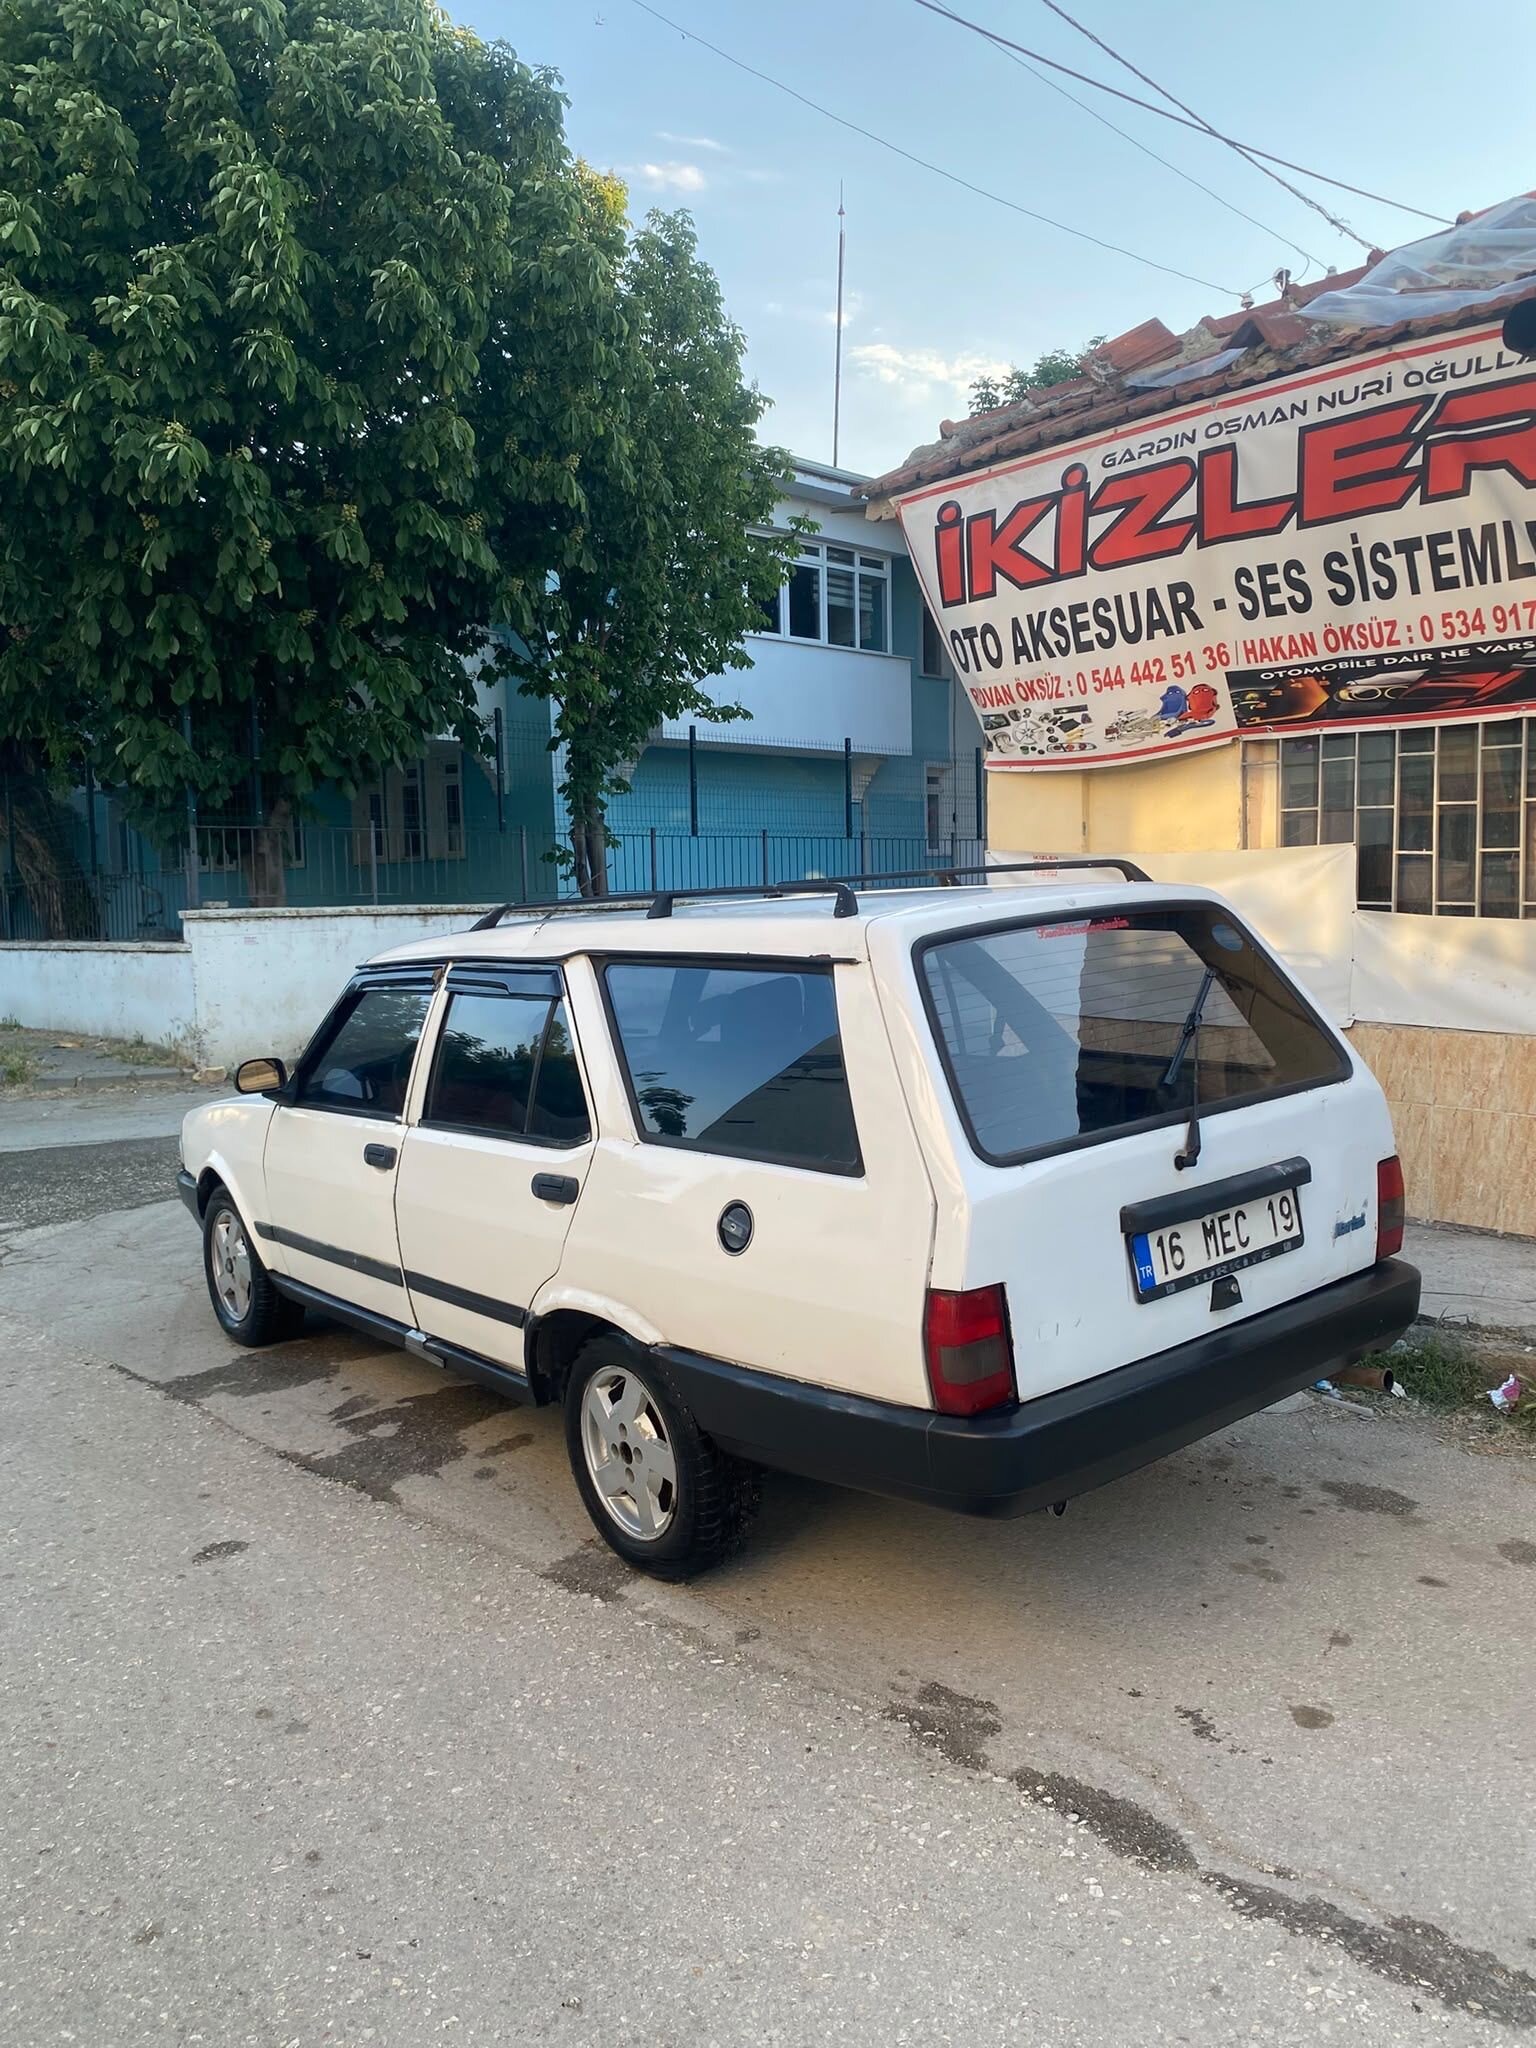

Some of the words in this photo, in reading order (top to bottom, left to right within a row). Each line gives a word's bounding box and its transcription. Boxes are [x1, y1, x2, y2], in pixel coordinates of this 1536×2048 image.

[1204, 400, 1308, 440] OSMAN
[1317, 371, 1393, 412] NURİ
[935, 373, 1536, 608] İKİZLER
[949, 622, 1003, 674] OTO
[1010, 580, 1205, 665] AKSESUAR
[1213, 598, 1227, 611] -
[1234, 558, 1313, 621] SES
[1015, 671, 1066, 703] ÖKSÜZ
[1076, 672, 1087, 695] 0
[1092, 665, 1124, 694] 544
[1130, 657, 1167, 686] 442
[1171, 651, 1197, 678] 51
[1202, 642, 1231, 671] 36
[1243, 630, 1319, 664] HAKAN
[1323, 615, 1401, 653] ÖKSÜZ
[1419, 615, 1434, 642] 0
[1442, 607, 1487, 640] 534
[1260, 658, 1377, 680] OTOMOBİLE
[1384, 653, 1434, 666] DAİR
[1440, 647, 1471, 660] NE
[1140, 1264, 1153, 1280] TR
[1156, 1231, 1185, 1276] 16
[1201, 1210, 1251, 1261] MEC
[1267, 1196, 1295, 1237] 19
